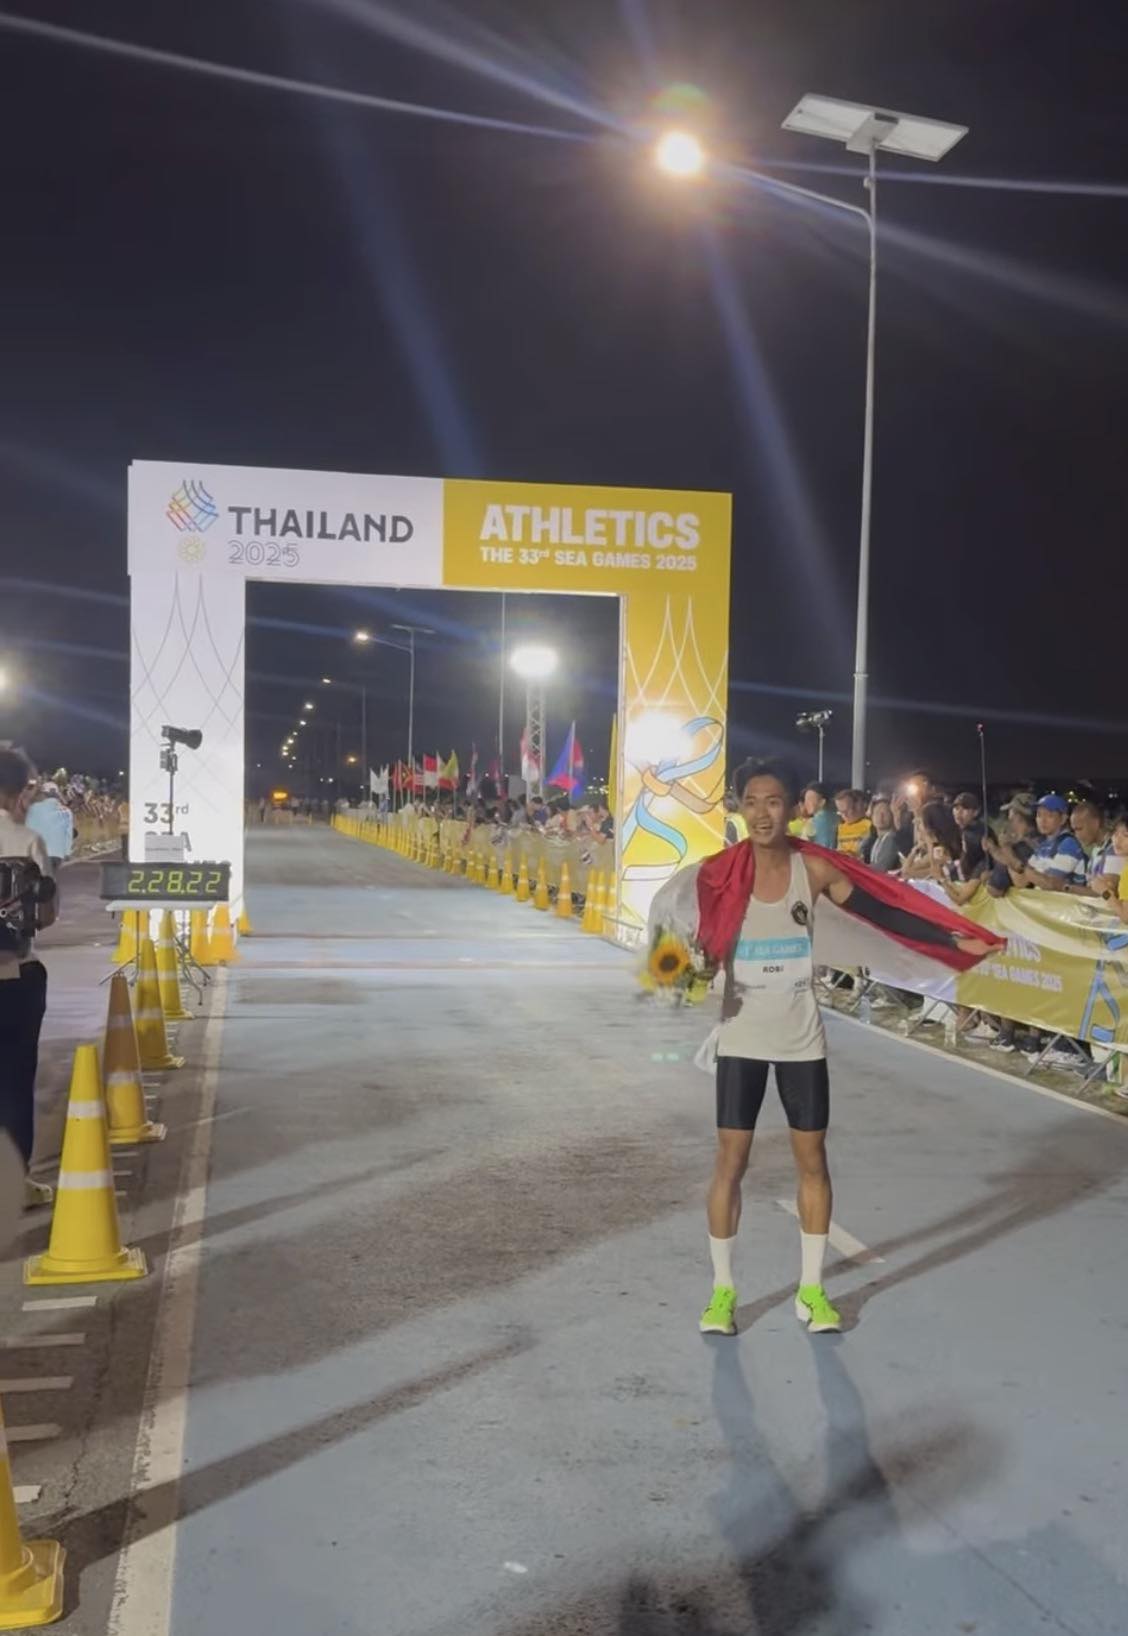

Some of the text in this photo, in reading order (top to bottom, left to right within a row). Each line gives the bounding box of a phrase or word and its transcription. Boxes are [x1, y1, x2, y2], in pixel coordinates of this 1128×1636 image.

[228, 505, 414, 543] THAILAND
[479, 504, 700, 550] ATHLETICS
[227, 539, 300, 567] 2025
[480, 547, 697, 571] THE 33rd SEA GAMES 2025
[144, 802, 189, 824] 33rd
